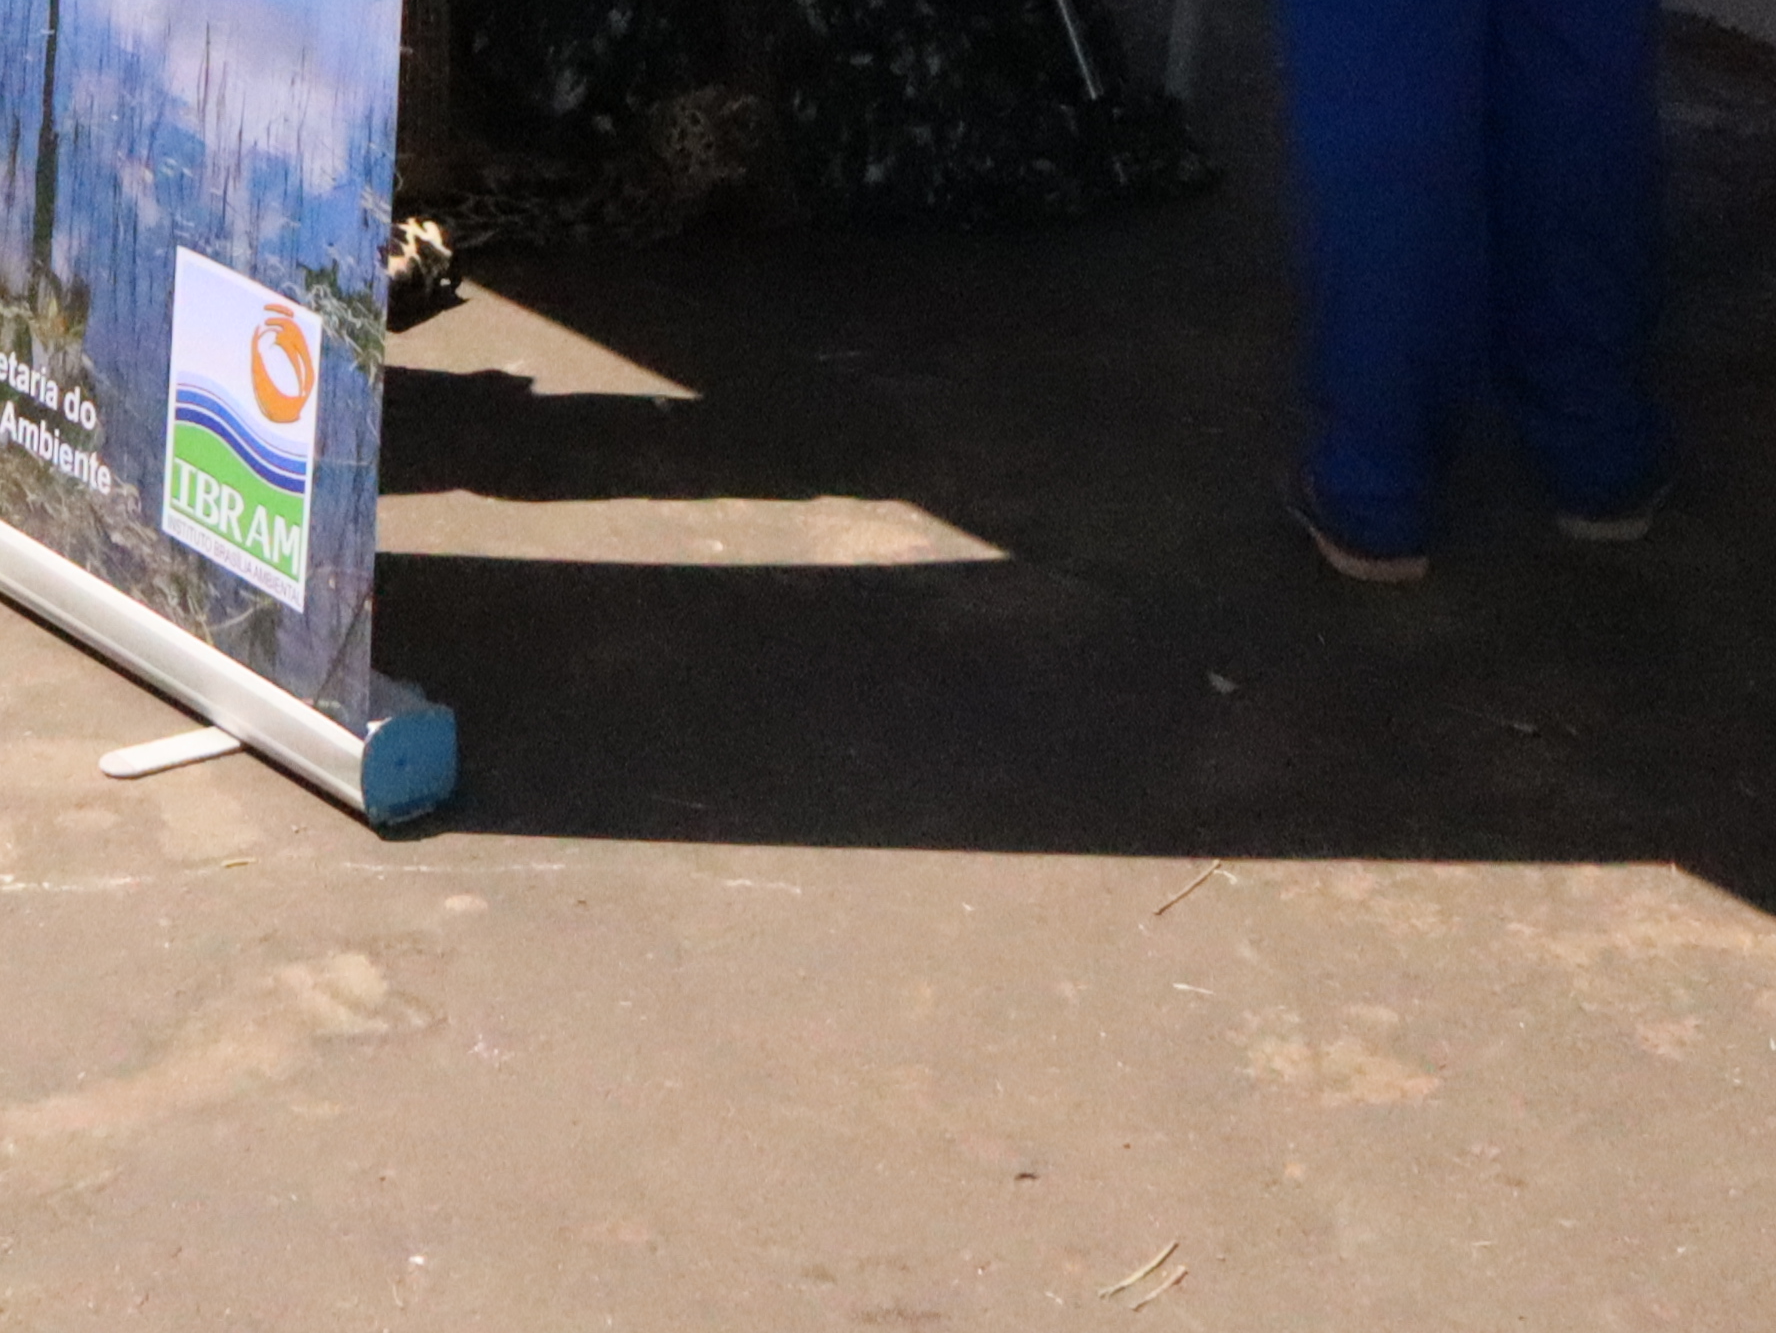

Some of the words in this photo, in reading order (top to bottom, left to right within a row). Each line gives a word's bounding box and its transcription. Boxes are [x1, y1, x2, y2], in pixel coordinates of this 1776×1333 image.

[63, 385, 97, 432] do
[167, 513, 213, 551] INSTITUTO
[253, 562, 302, 606] AMBIENTAL
[171, 456, 302, 576] IBRAM
